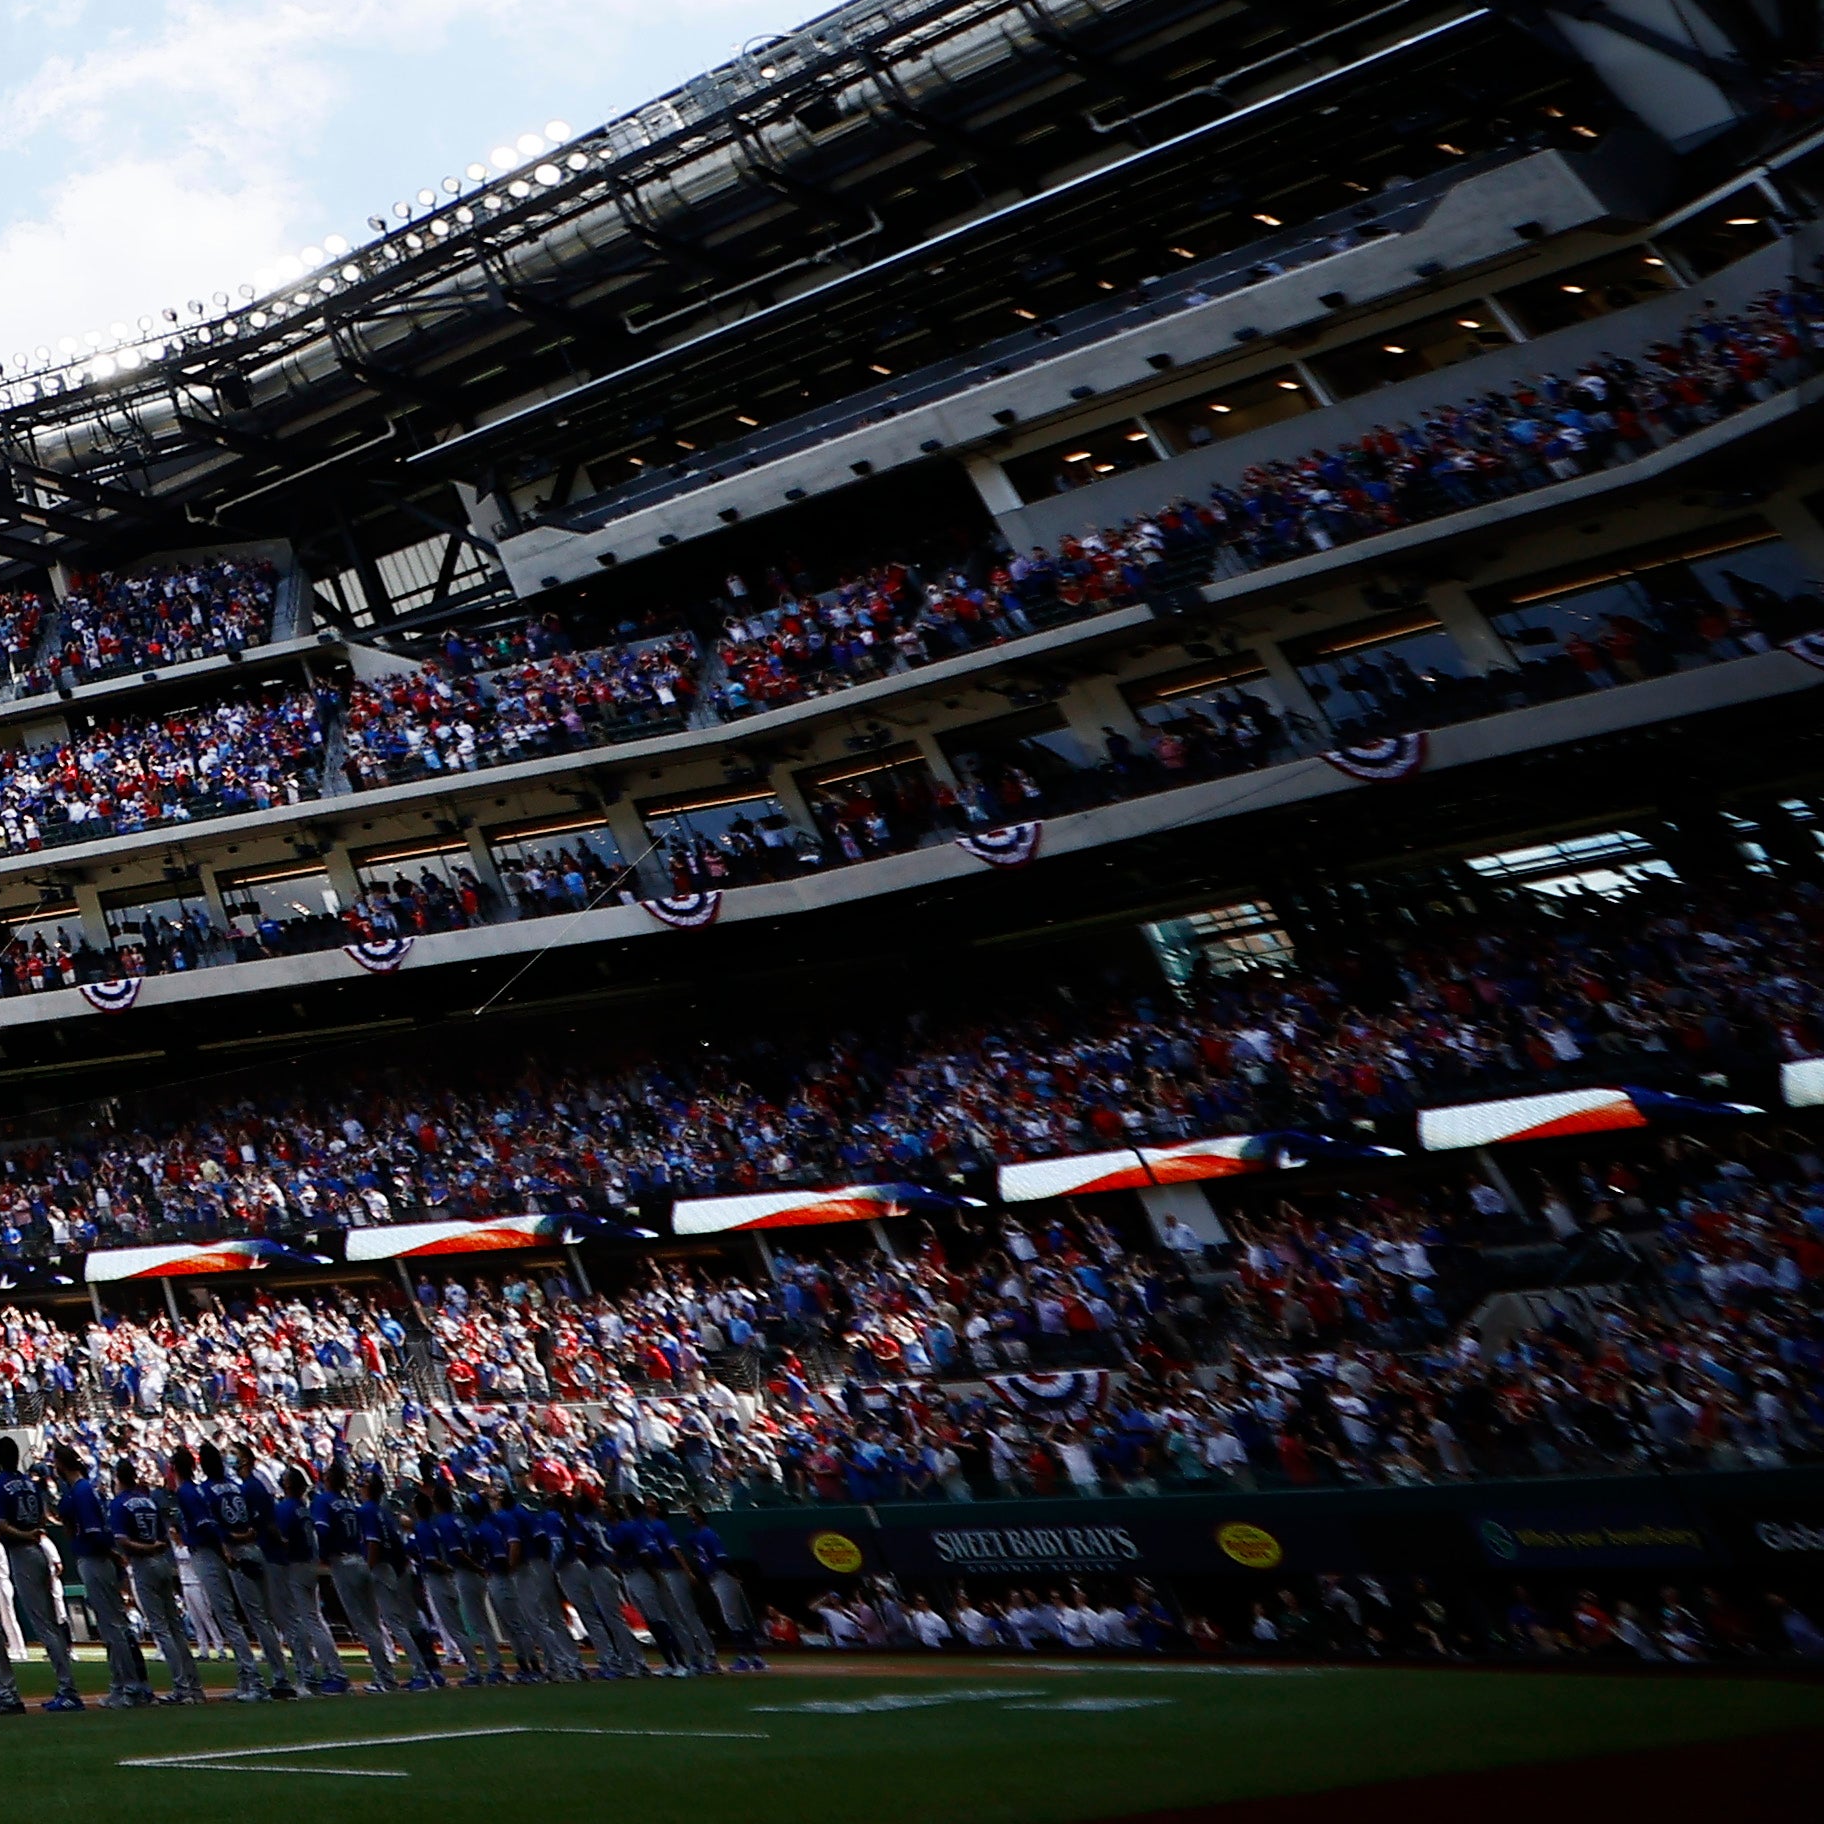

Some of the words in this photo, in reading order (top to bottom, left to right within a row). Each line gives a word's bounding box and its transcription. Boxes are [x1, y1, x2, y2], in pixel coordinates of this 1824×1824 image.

[220, 1495, 249, 1524] 68
[134, 1513, 158, 1540] 57
[933, 1530, 1008, 1563] SWEET
[1004, 1528, 1070, 1557] BABY
